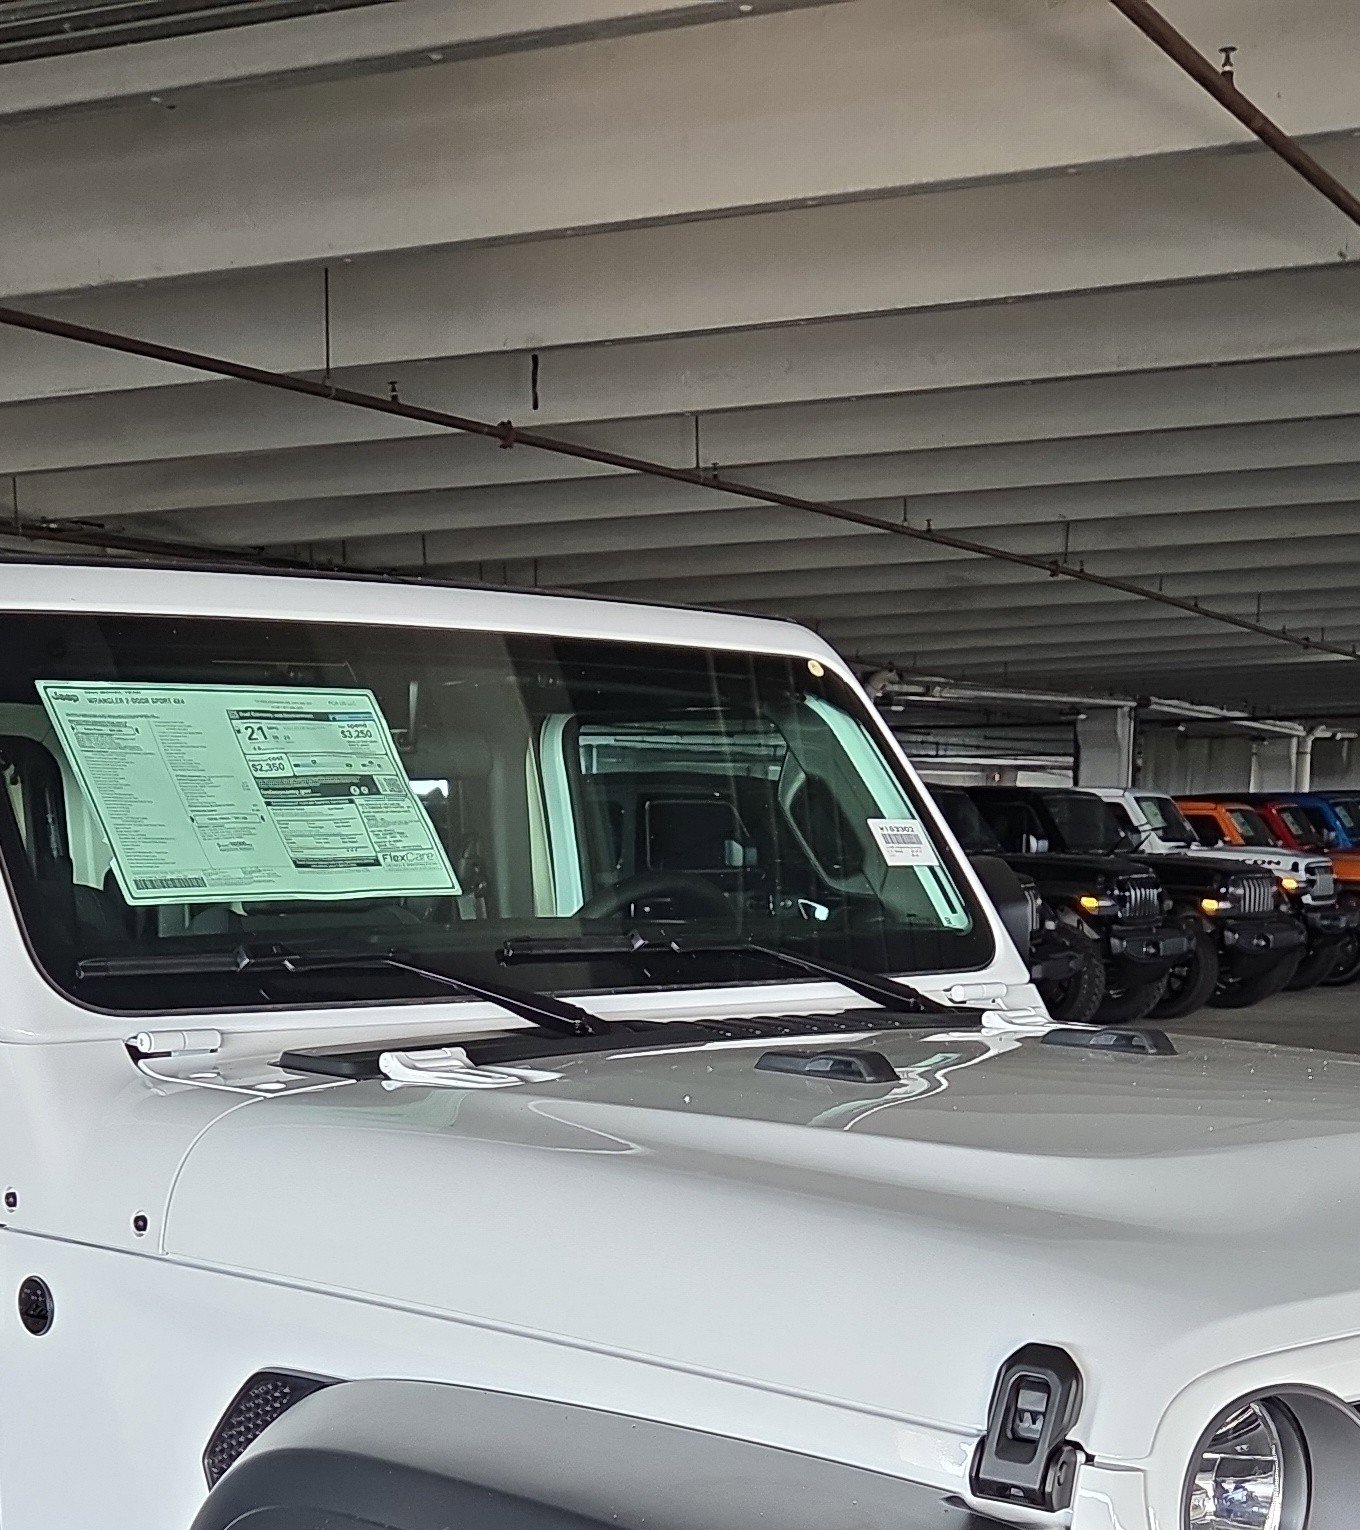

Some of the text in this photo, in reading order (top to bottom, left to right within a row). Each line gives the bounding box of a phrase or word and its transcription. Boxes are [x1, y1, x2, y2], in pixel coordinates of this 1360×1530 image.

[244, 725, 268, 740] 21
[341, 729, 373, 739] $3,250
[251, 763, 285, 772] $2,350
